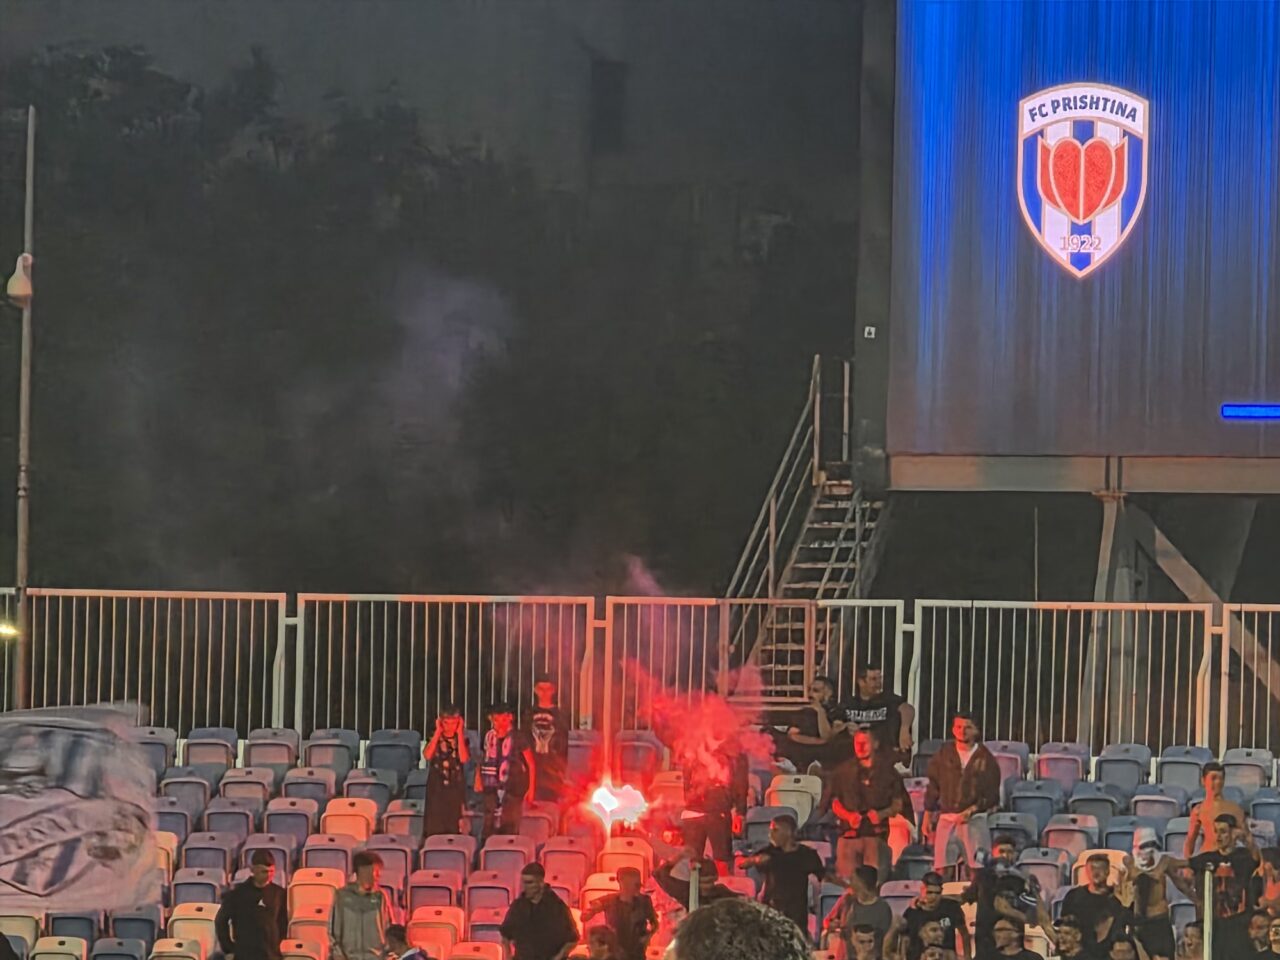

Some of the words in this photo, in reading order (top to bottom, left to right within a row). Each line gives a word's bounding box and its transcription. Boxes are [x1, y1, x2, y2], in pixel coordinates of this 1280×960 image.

[1028, 103, 1049, 122] FC
[1051, 94, 1138, 123] PRISHTINA
[1059, 235, 1101, 252] 1922
